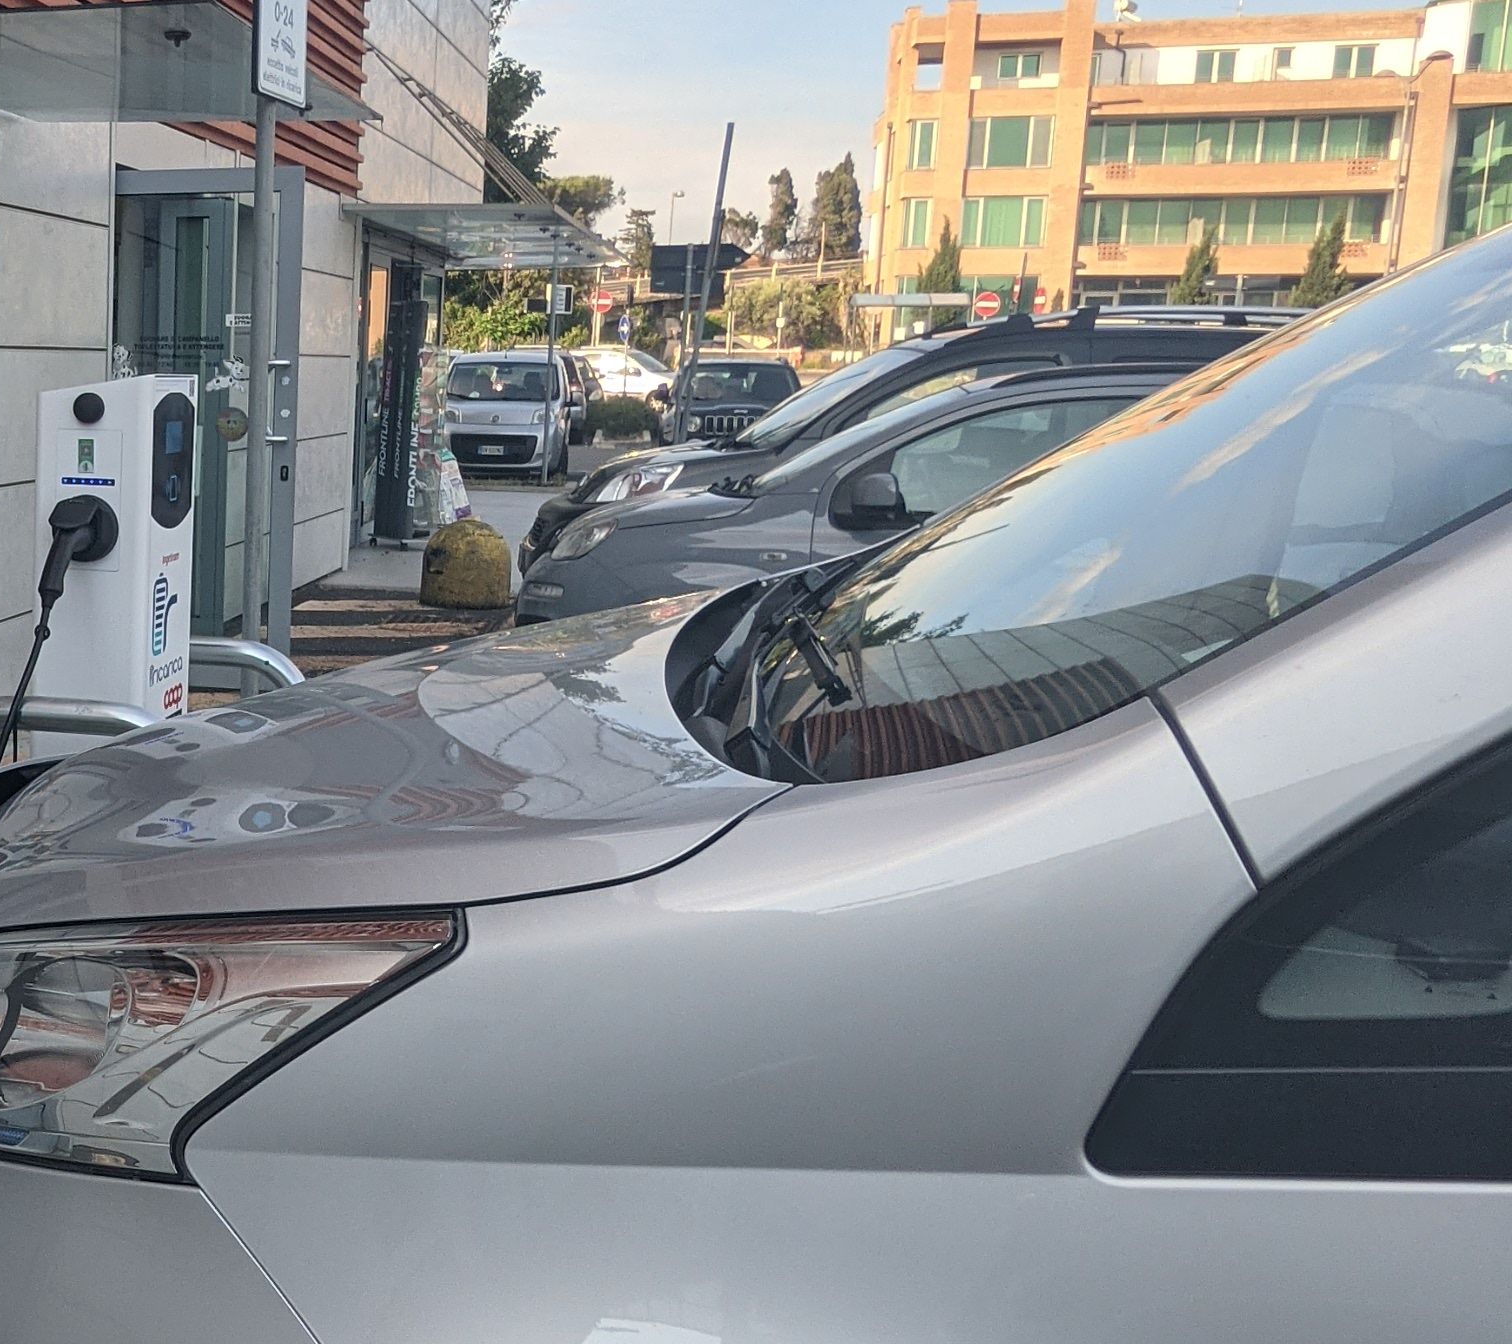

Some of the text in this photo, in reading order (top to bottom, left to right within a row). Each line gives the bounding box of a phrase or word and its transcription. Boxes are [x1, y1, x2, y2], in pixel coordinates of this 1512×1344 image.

[274, 1, 294, 29] 0-24
[378, 407, 390, 477] FRONTLINE
[393, 408, 403, 480] FRONTLINE
[164, 682, 183, 709] coop
